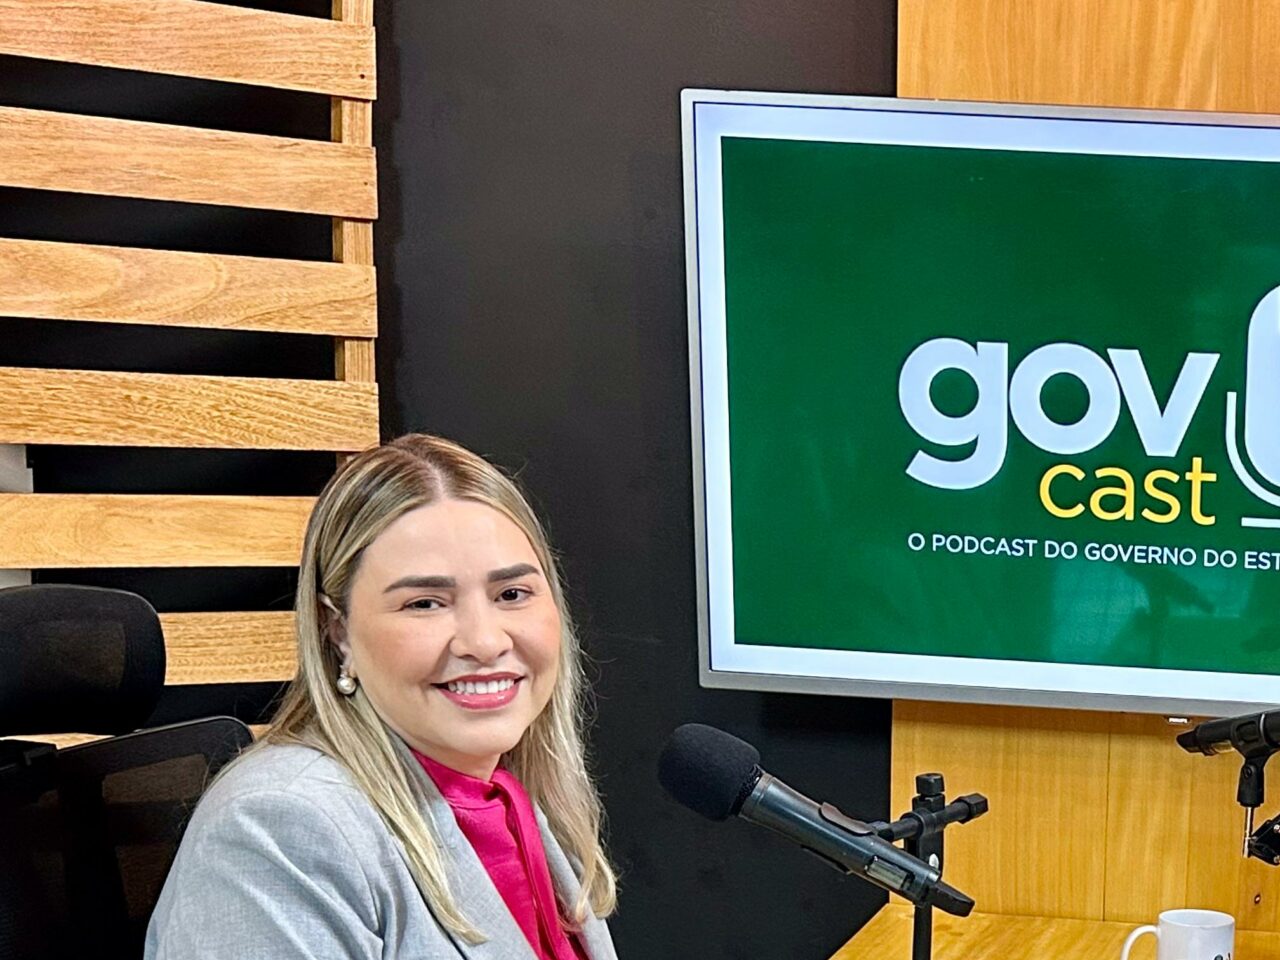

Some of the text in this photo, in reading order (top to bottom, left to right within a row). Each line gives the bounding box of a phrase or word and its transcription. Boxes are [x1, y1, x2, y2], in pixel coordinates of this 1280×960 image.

[899, 337, 1220, 490] gov
[1039, 456, 1217, 526] cast
[907, 532, 925, 551] O
[932, 533, 1037, 557] PODCAST
[1044, 540, 1078, 559] DO
[1084, 543, 1197, 567] GOVERNO
[1203, 549, 1237, 568] DO
